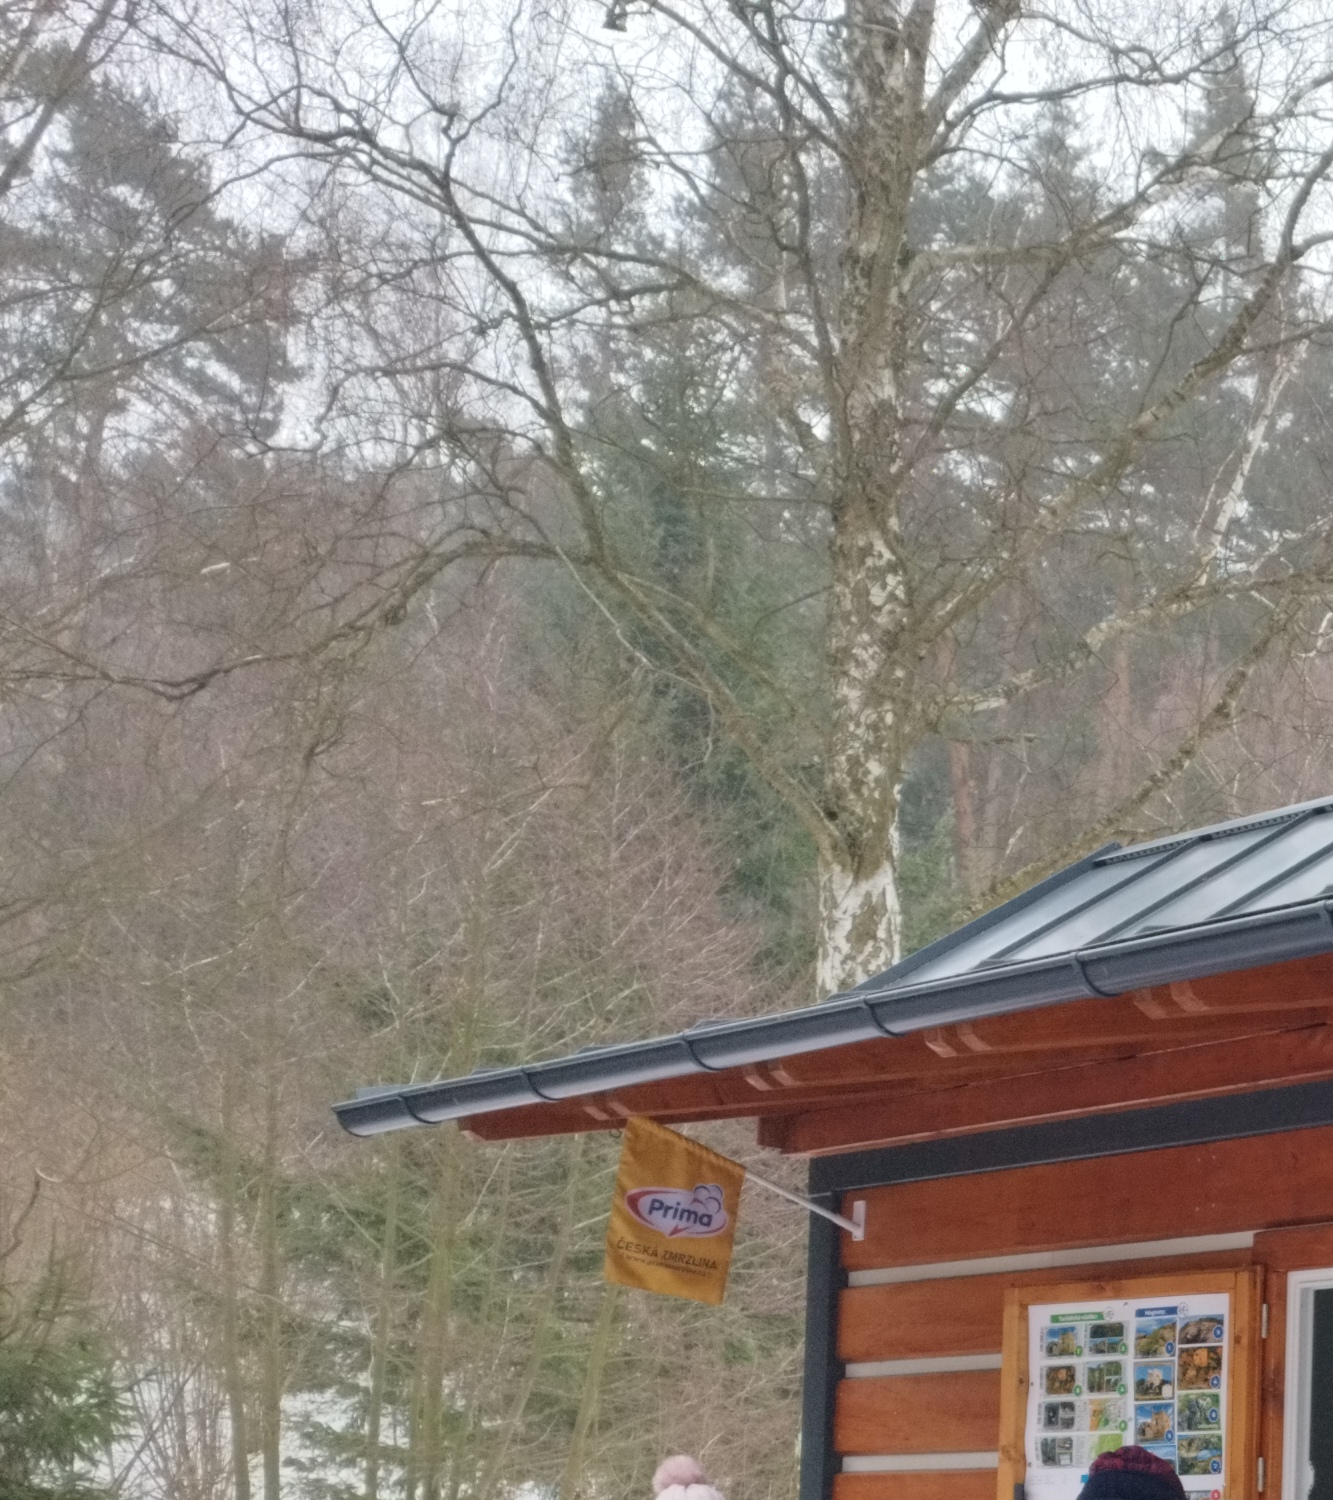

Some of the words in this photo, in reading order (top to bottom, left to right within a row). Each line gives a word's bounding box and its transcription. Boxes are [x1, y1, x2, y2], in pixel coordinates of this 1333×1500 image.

[648, 1198, 713, 1228] Prima
[616, 1236, 658, 1258] ČESKÁ
[661, 1249, 719, 1271] ZMRZLINA
